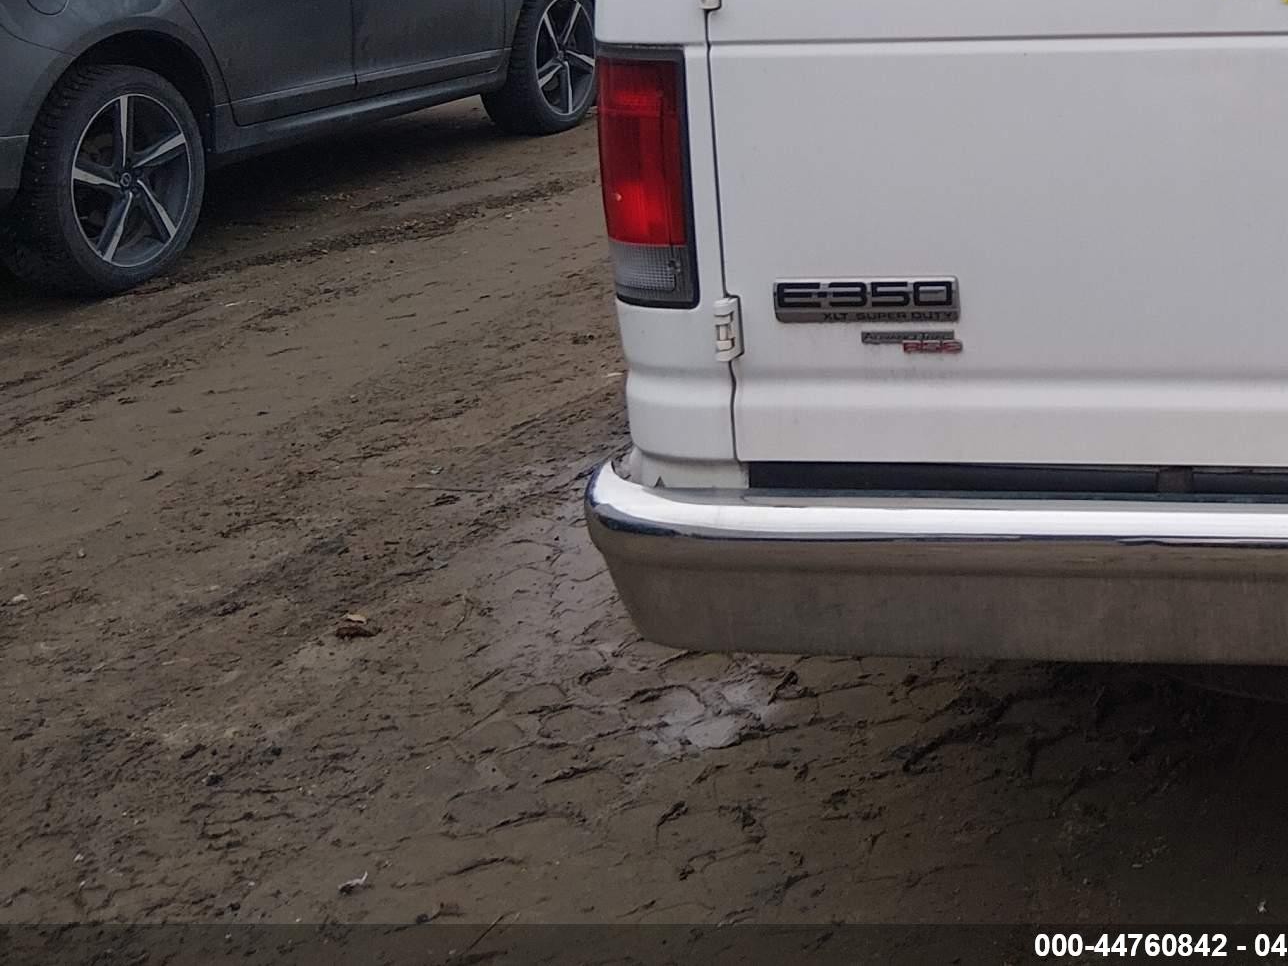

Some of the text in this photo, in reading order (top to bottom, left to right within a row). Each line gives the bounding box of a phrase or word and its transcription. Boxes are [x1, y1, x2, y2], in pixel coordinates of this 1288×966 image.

[823, 311, 953, 321] XLT SUPER DUTY
